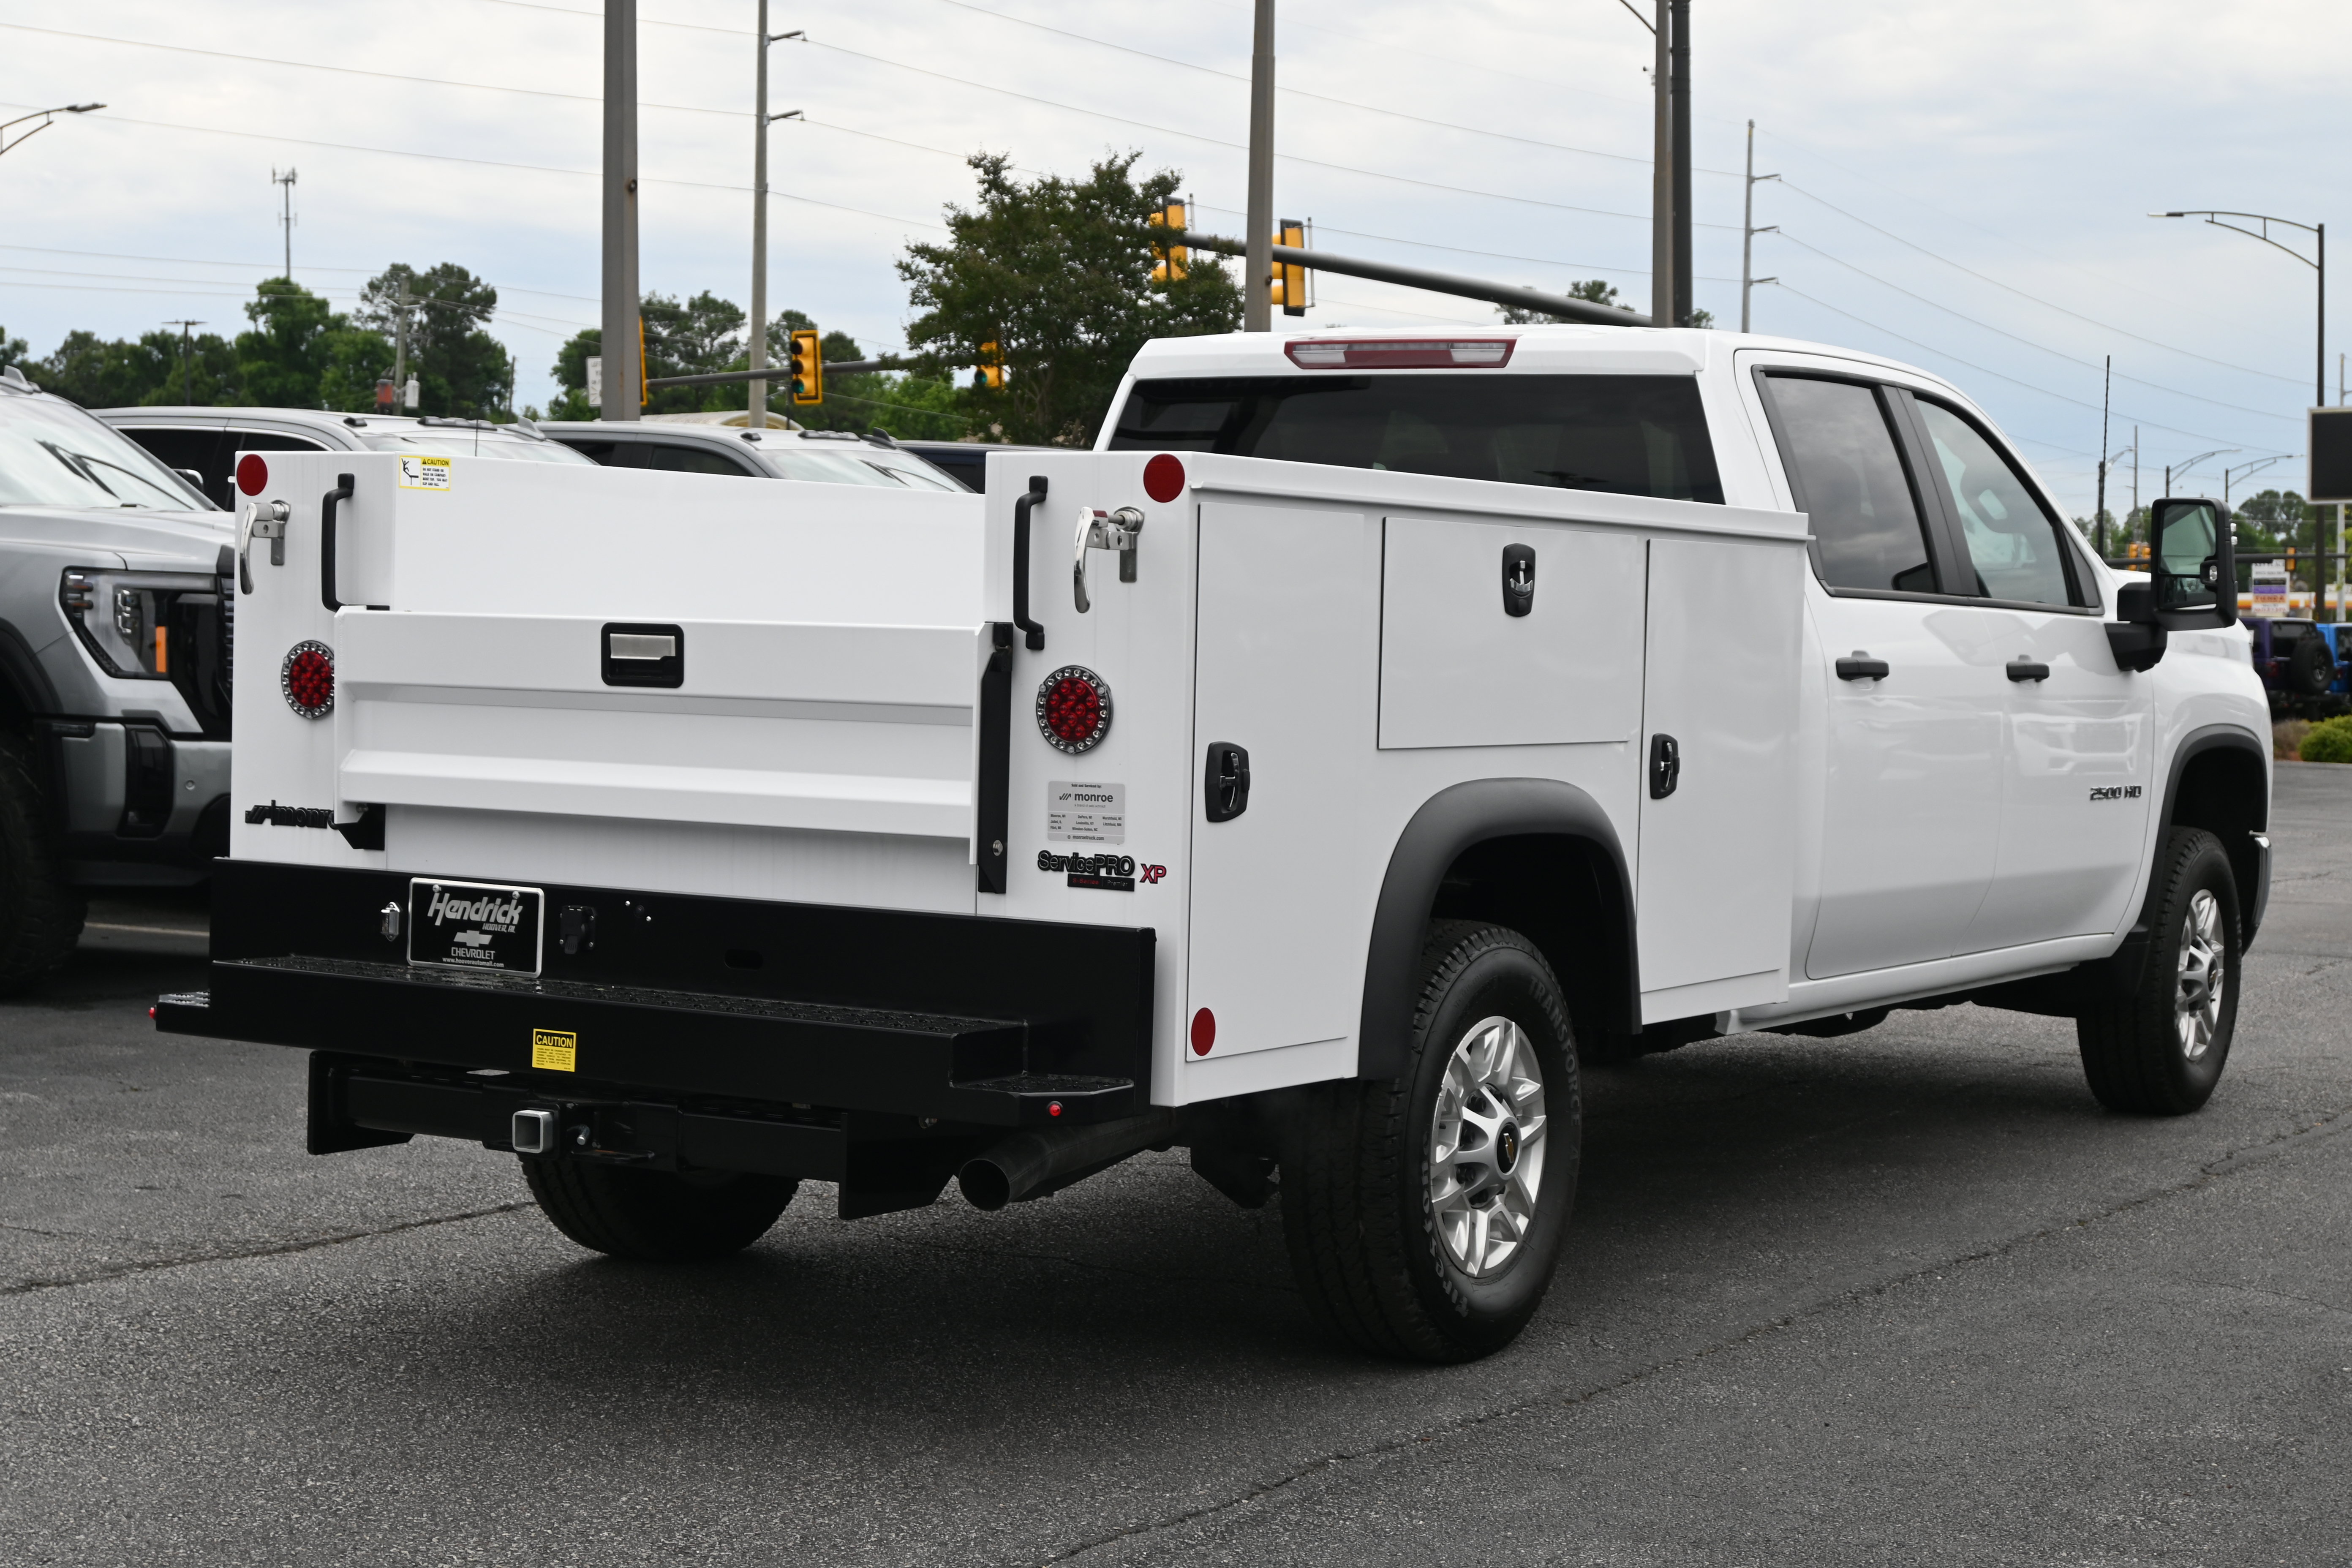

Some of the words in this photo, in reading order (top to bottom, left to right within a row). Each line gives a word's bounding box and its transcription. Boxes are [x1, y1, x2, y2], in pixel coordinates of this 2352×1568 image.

[1074, 793, 1113, 802] monroe
[2090, 785, 2122, 800] 2500
[2124, 784, 2142, 798] HD
[275, 805, 339, 830] monro
[1037, 850, 1135, 877] ServicePRO
[1139, 863, 1167, 884] XP
[427, 893, 523, 926] Hendrick
[482, 923, 507, 933] HOOVER,
[451, 947, 495, 960] CHEVROLET
[442, 957, 504, 967] www.hooverautomall.com
[536, 1034, 572, 1048] CAUTION
